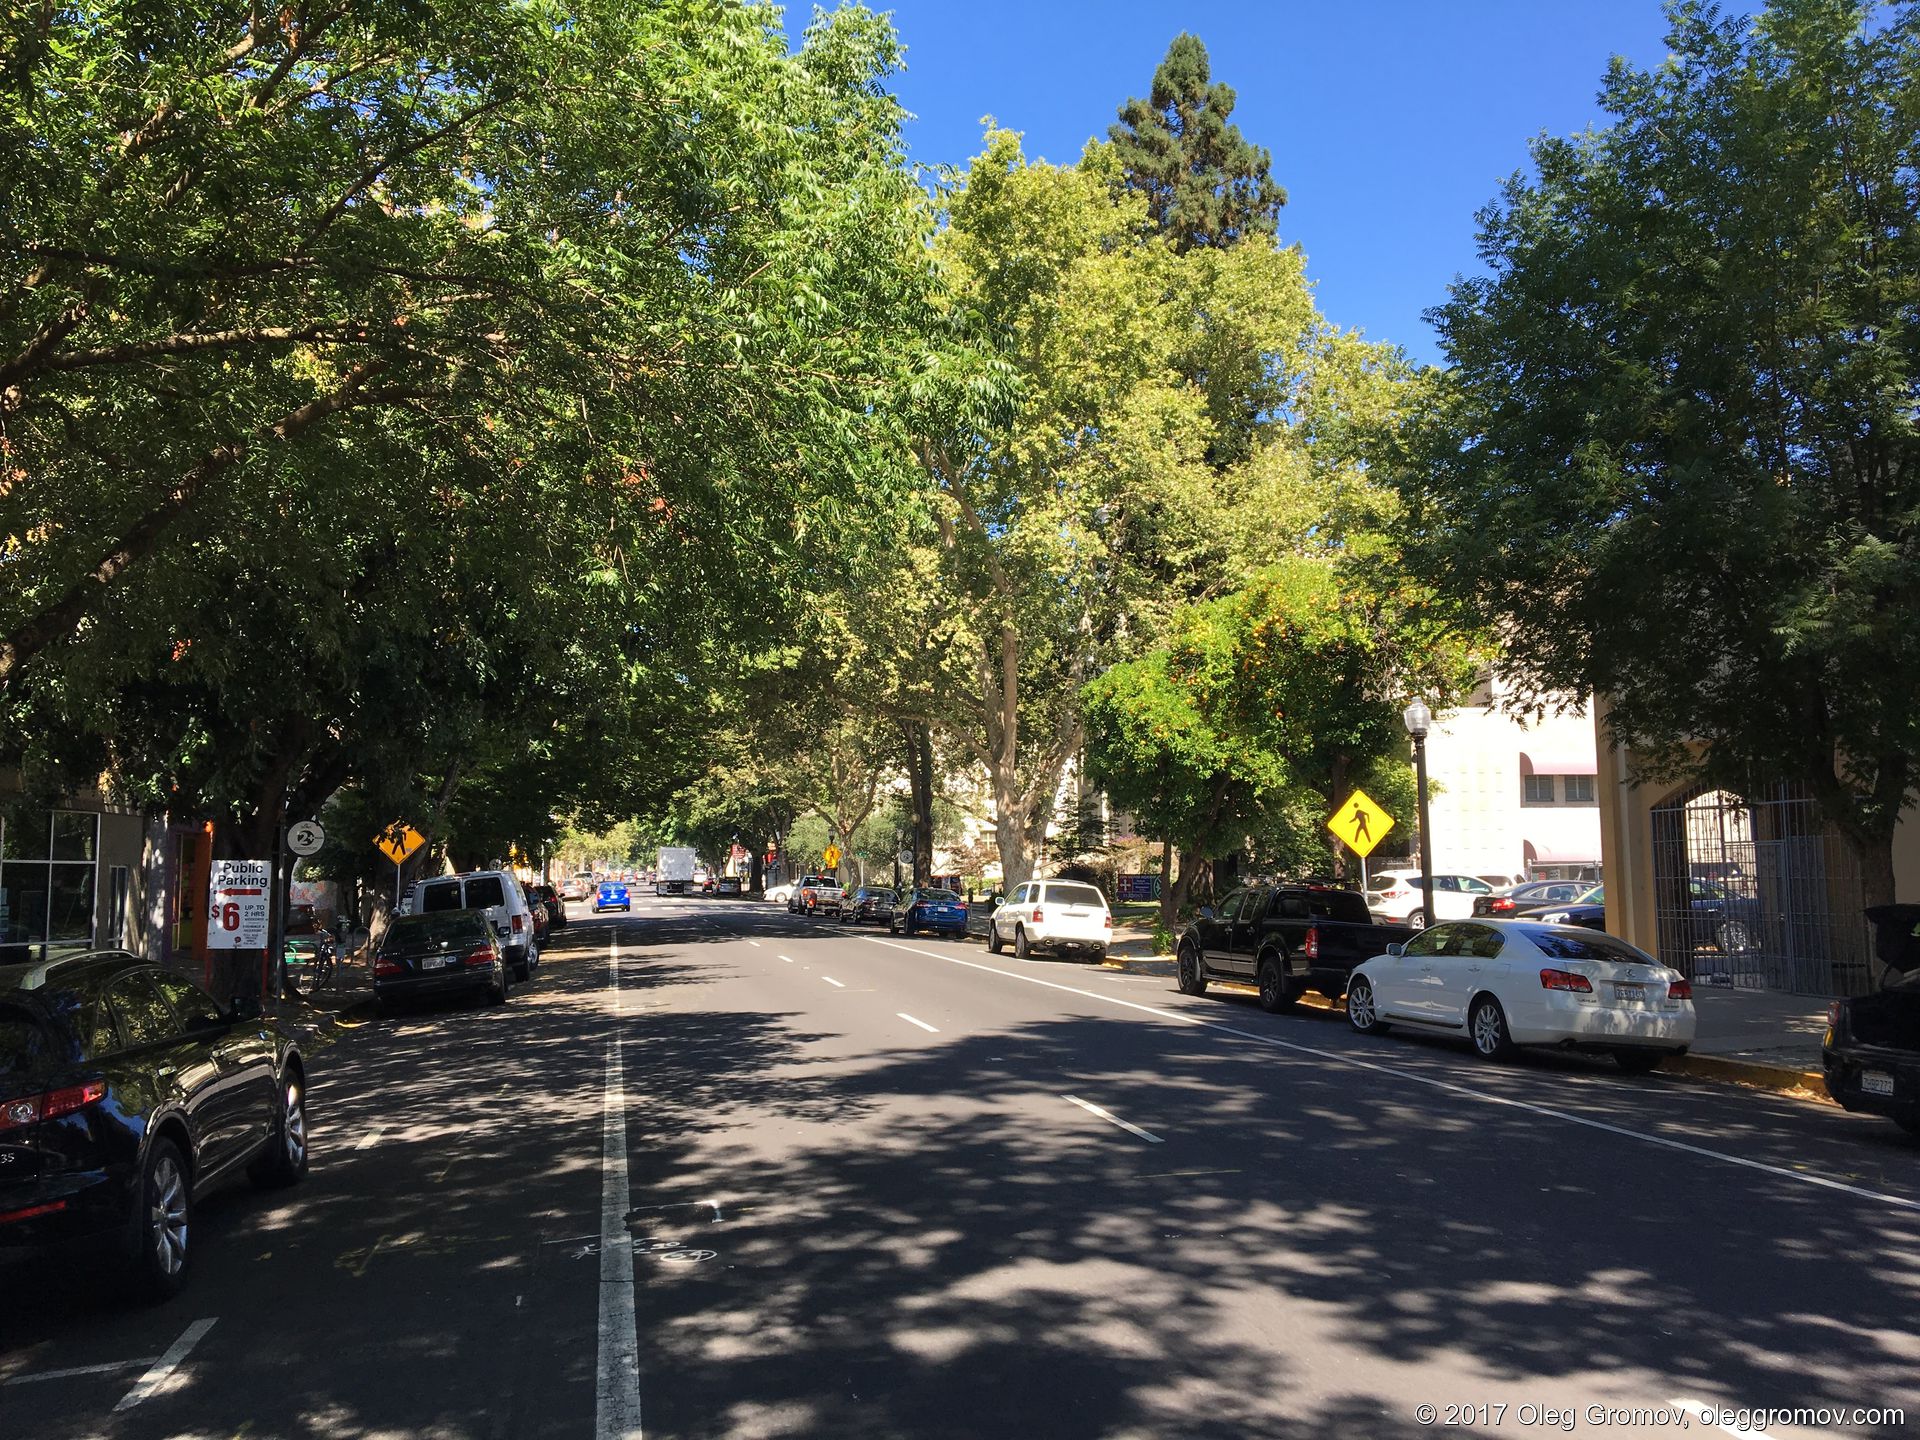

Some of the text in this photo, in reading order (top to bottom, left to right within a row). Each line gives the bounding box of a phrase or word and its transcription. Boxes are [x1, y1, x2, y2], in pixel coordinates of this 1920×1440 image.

[223, 862, 264, 874] Public
[217, 874, 268, 888] Parking
[211, 902, 240, 932] $6
[1, 1152, 15, 1164] 35
